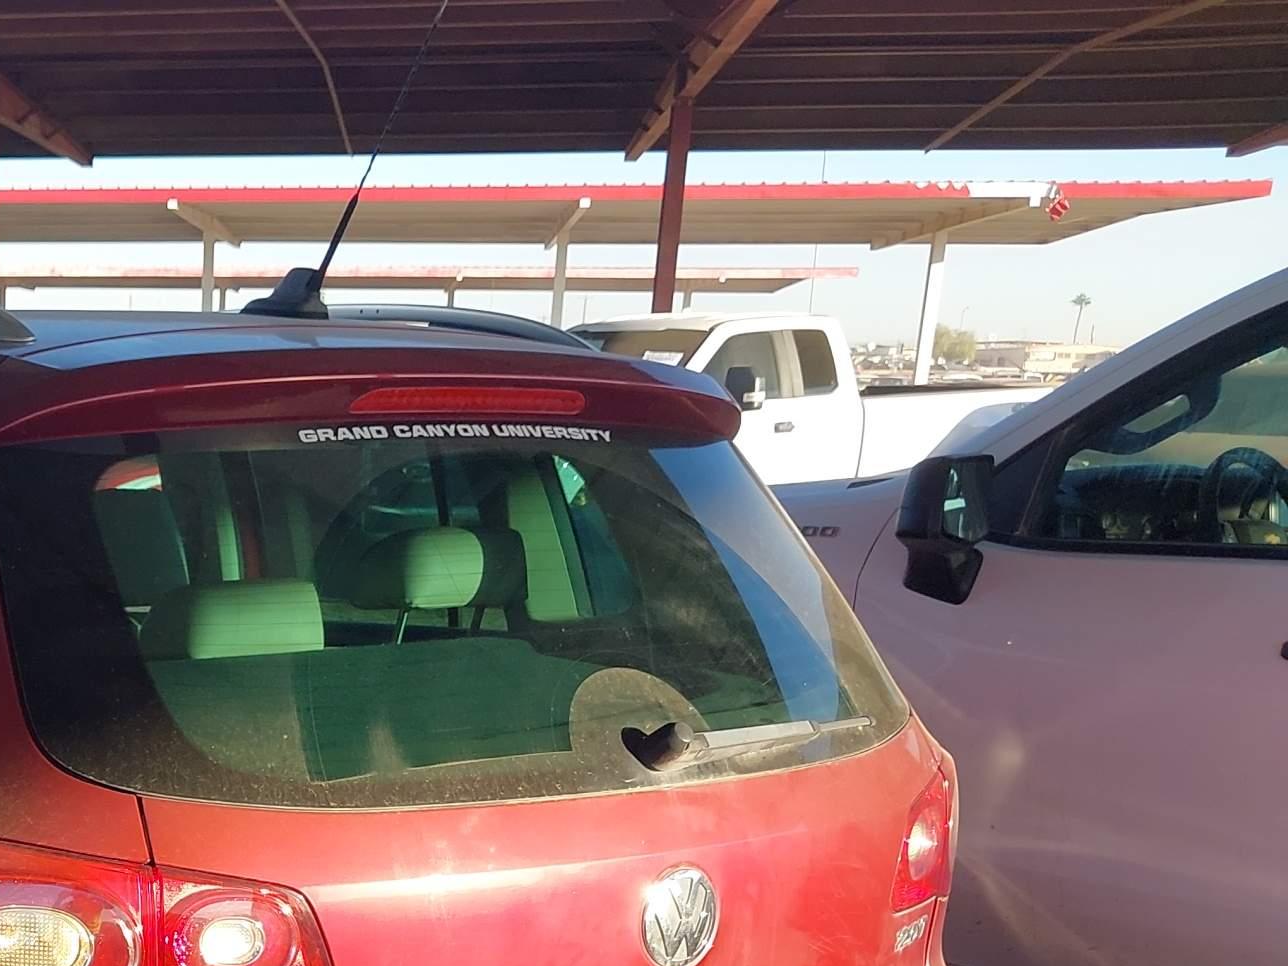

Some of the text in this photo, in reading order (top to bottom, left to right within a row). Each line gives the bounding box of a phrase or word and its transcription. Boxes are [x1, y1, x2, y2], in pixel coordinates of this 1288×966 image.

[298, 424, 611, 443] GRAND CANYON UNIVERSITY
